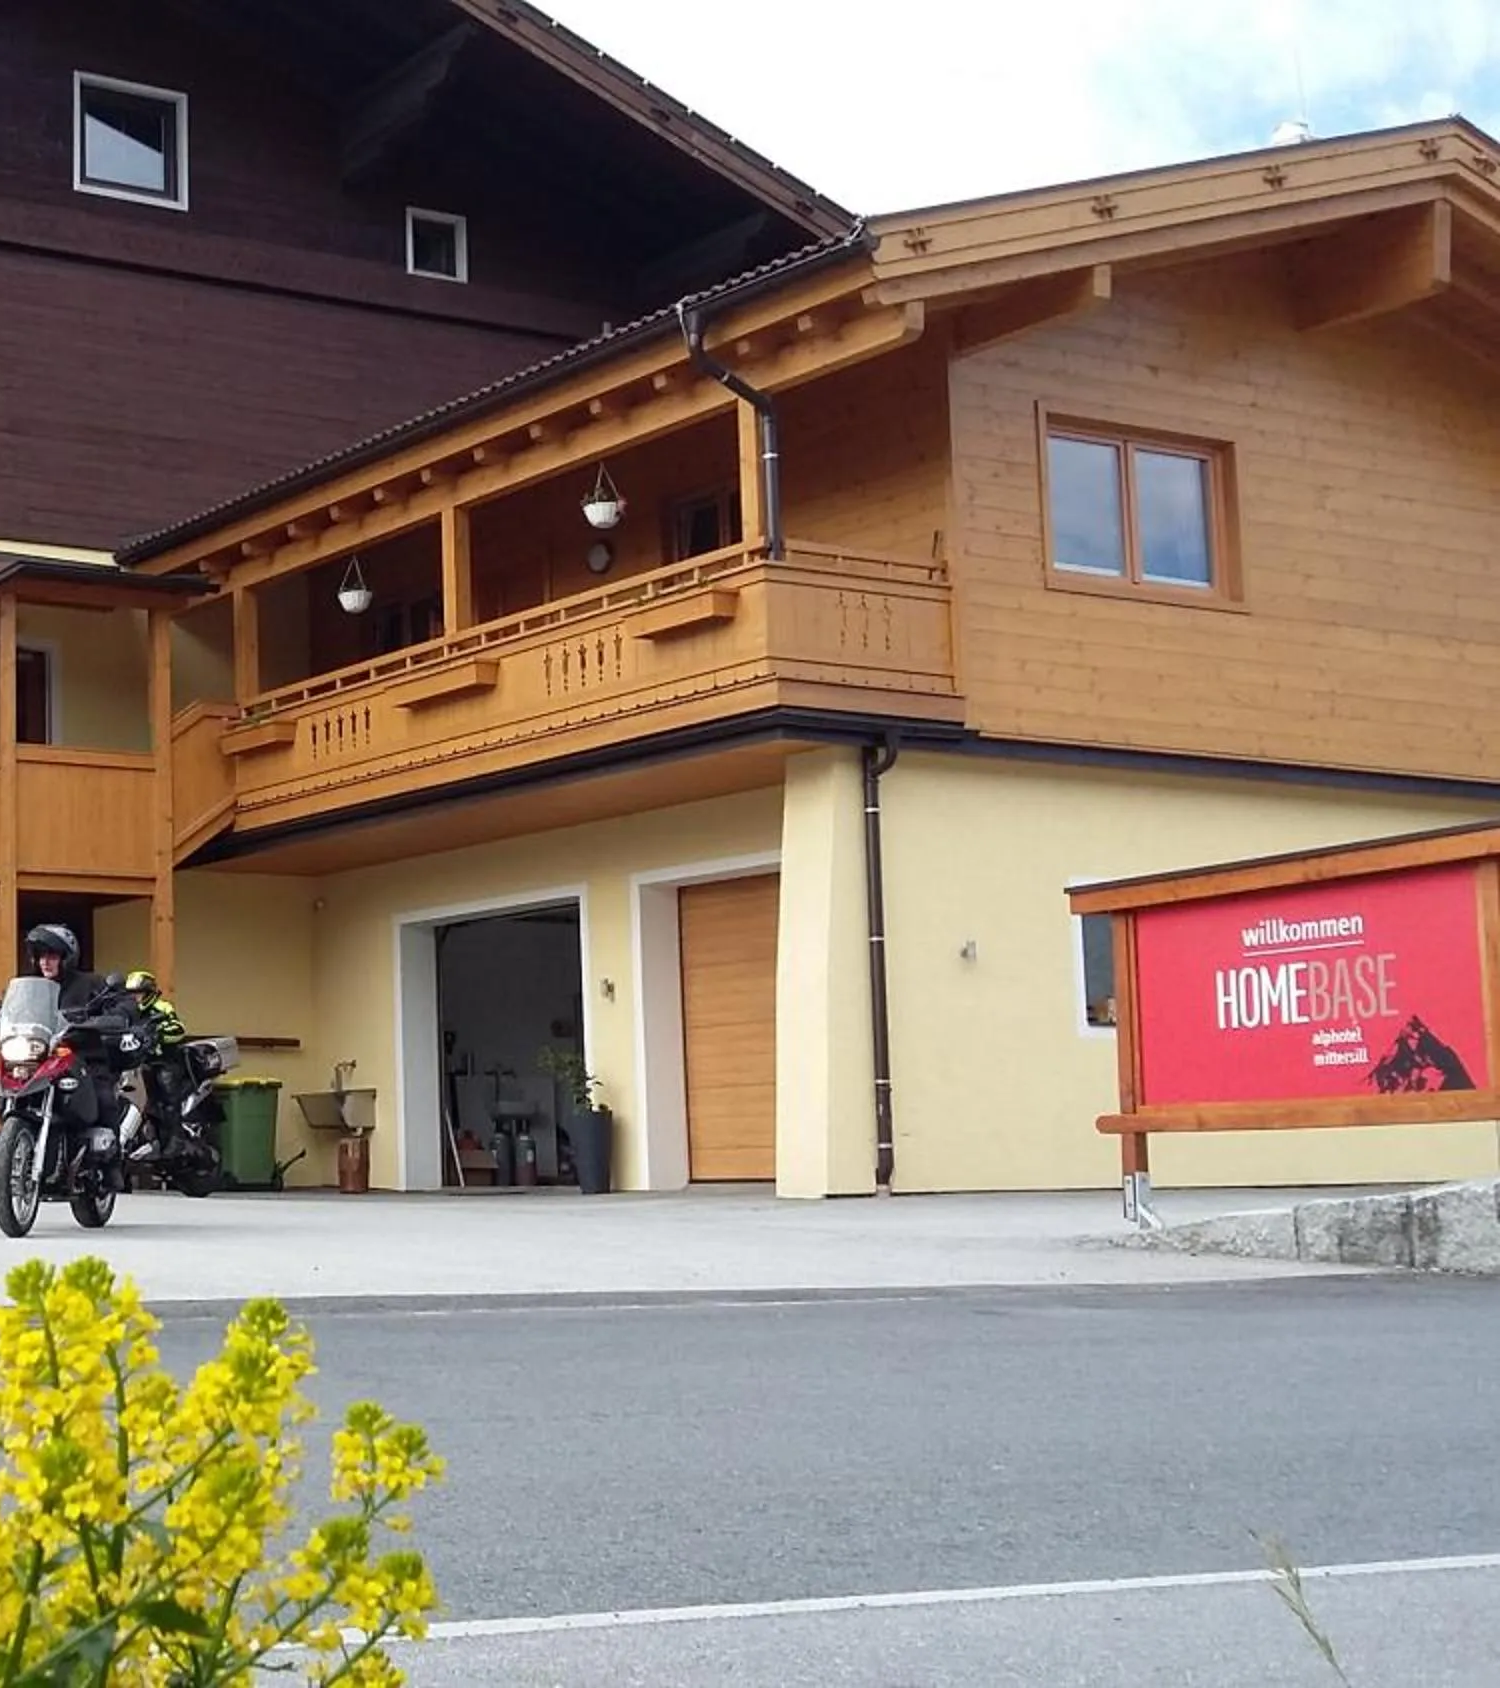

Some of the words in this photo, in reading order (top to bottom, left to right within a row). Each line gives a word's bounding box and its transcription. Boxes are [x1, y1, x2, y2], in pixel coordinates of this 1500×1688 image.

[1242, 915, 1364, 947] willkommen
[1215, 953, 1399, 1029] HOMEBASE
[1312, 1026, 1363, 1046] alphotel
[1314, 1047, 1369, 1066] mittersill
